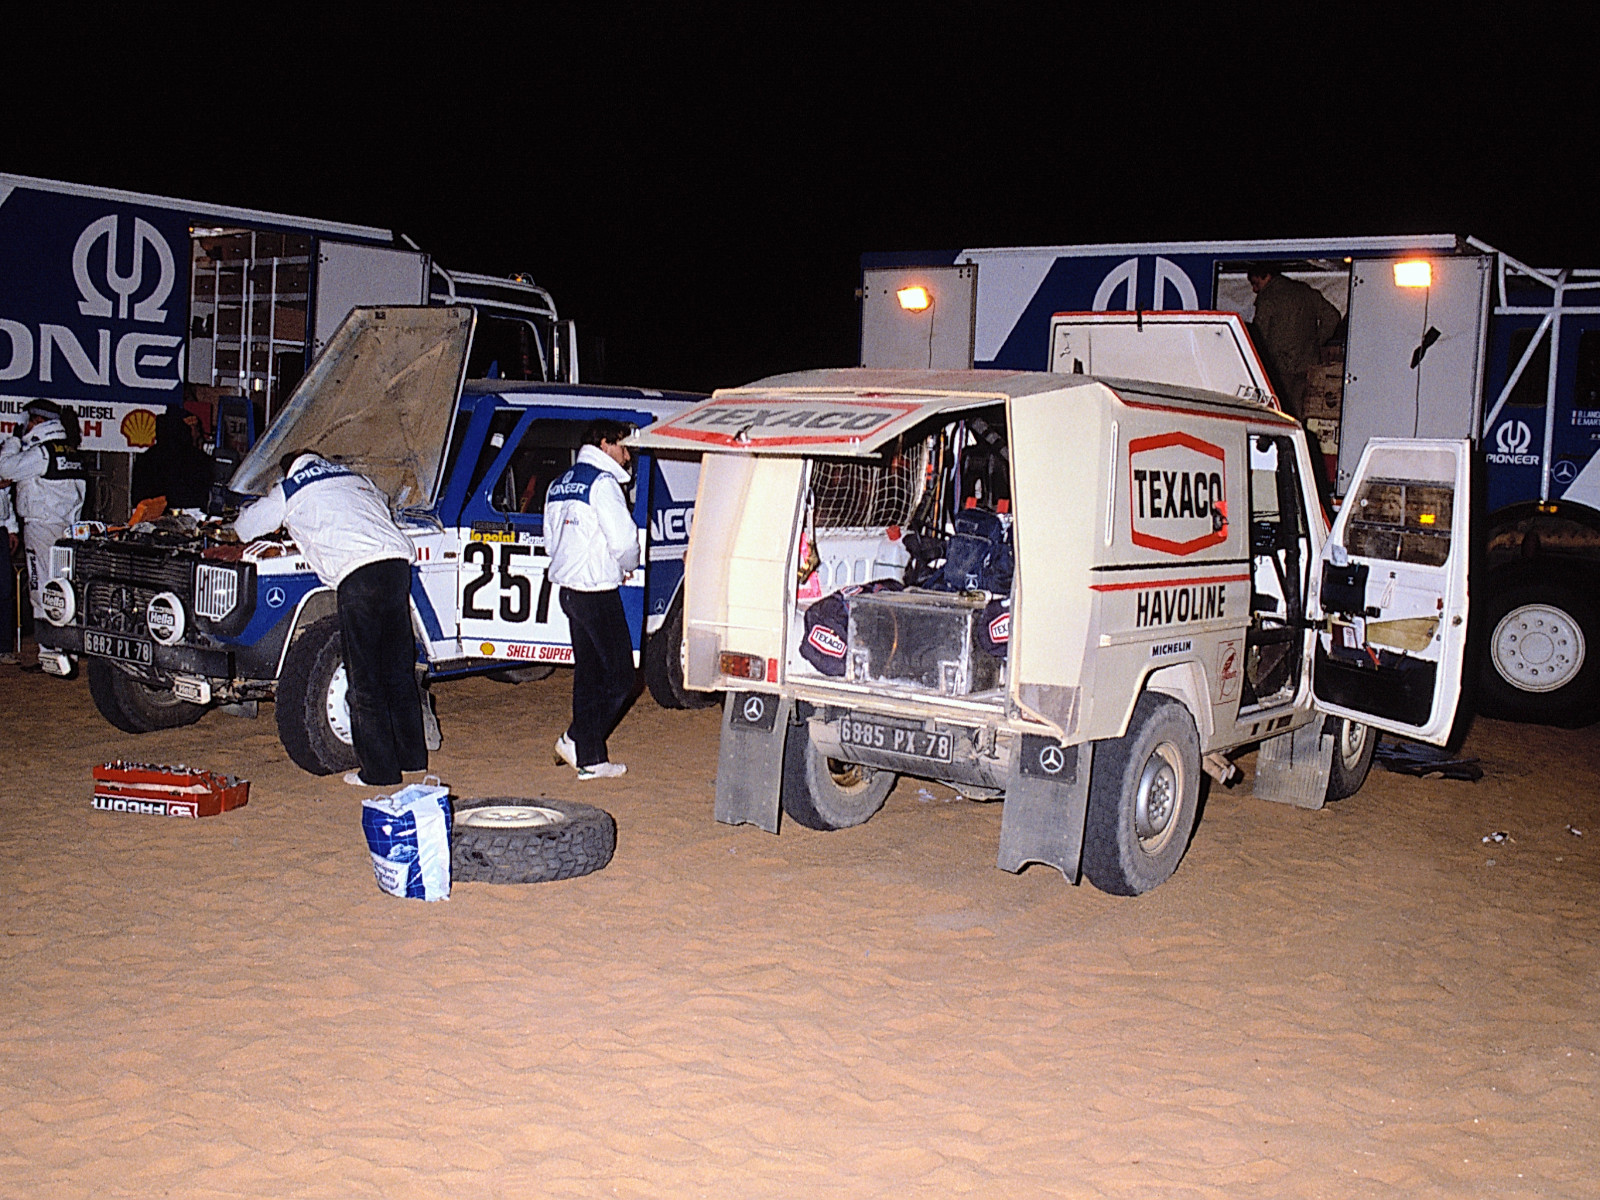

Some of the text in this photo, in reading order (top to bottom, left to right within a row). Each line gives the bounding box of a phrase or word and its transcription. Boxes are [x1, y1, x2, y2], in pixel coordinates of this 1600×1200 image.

[0, 319, 184, 390] ONE
[78, 405, 116, 420] DIESEL
[685, 408, 893, 432] TEXACO
[1486, 453, 1540, 465] PIONEER
[293, 464, 350, 485] PIONEE
[549, 482, 588, 496] ONEER
[1134, 470, 1222, 520] TEXACO
[482, 530, 515, 545] point
[462, 542, 553, 624] 257
[43, 594, 65, 609] Hella
[1136, 585, 1226, 628] HAVOLINE
[149, 612, 174, 625] Hella
[86, 633, 112, 655] 6882
[116, 639, 130, 659] PX
[815, 631, 843, 651] TEXACO
[1152, 641, 1191, 657] MICHELIN
[507, 644, 574, 661] SHELL SUPER
[841, 720, 885, 748] 6885
[893, 729, 915, 752] PX
[91, 797, 165, 815] FACOM
